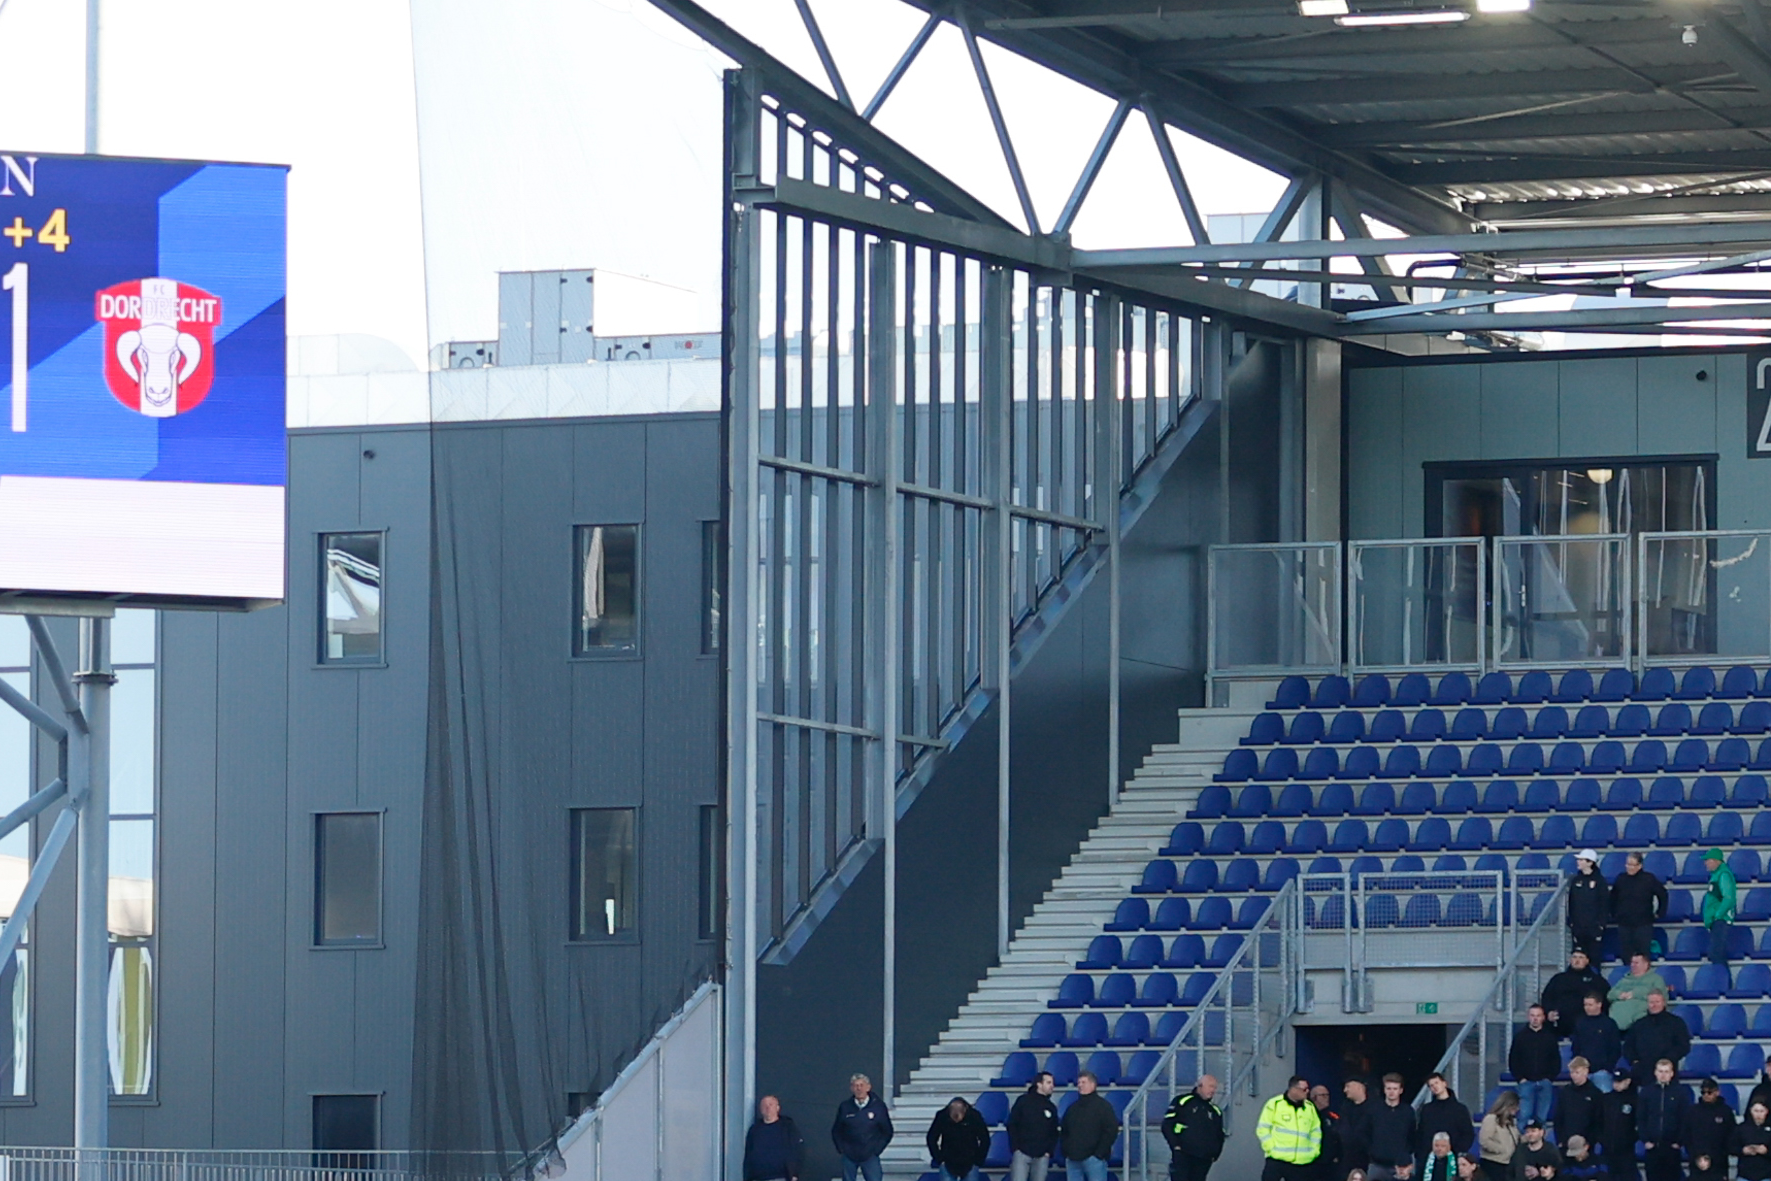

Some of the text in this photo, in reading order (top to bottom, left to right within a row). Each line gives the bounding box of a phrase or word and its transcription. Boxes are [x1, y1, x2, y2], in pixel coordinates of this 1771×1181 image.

[3, 208, 70, 253] +4
[100, 294, 217, 322] DORDRECHT
[2, 262, 28, 433] 1
